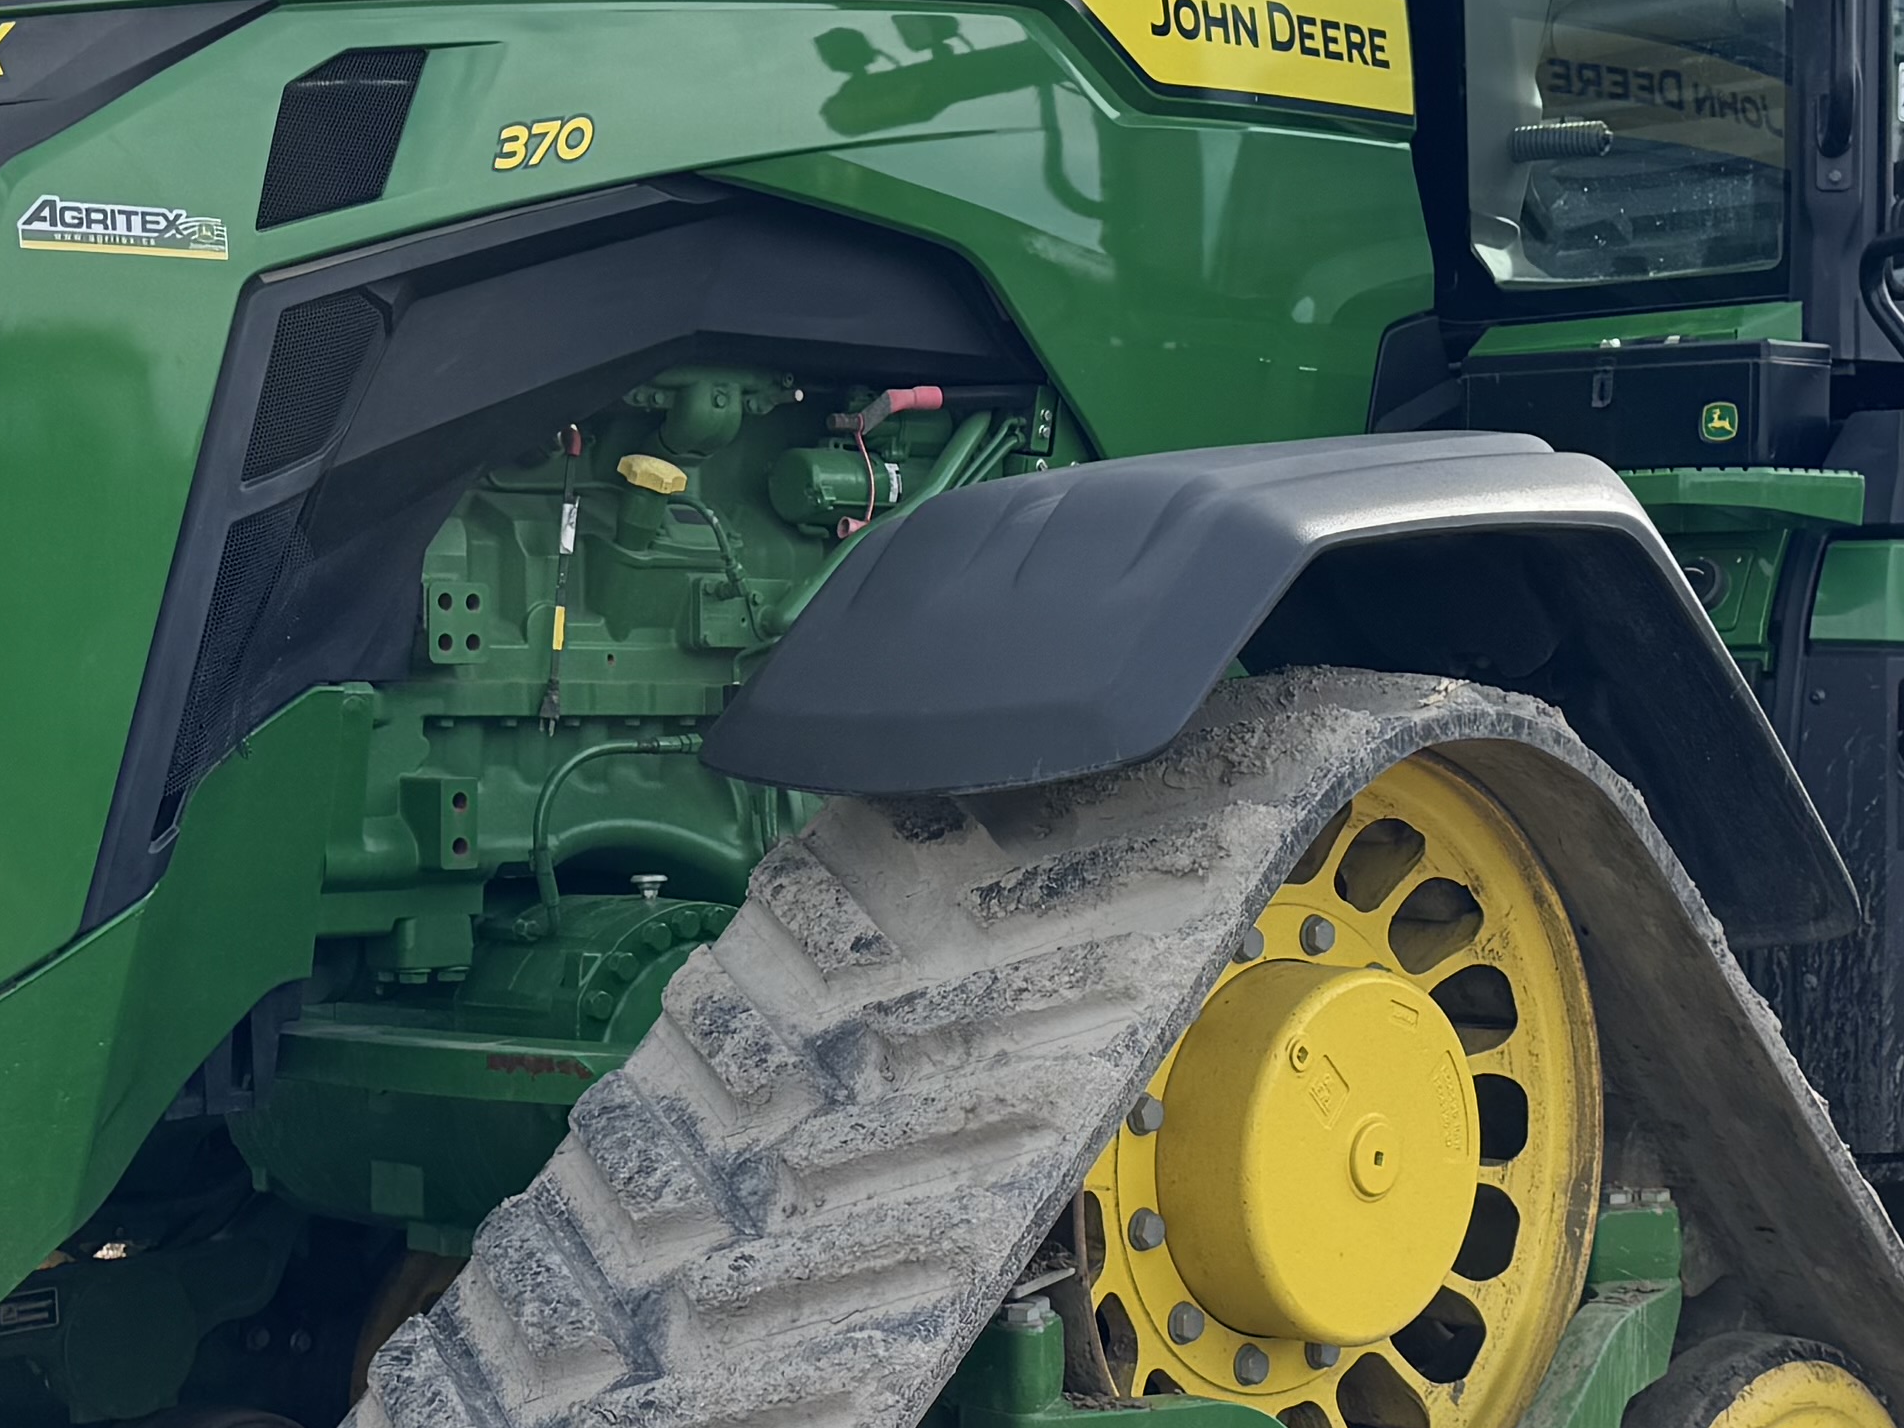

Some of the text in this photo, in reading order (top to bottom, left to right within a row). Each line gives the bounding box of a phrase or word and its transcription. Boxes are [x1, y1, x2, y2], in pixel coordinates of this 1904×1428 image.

[1266, 0, 1390, 69] DEERE
[494, 116, 593, 170] 370
[22, 199, 185, 238] AGRITEX
